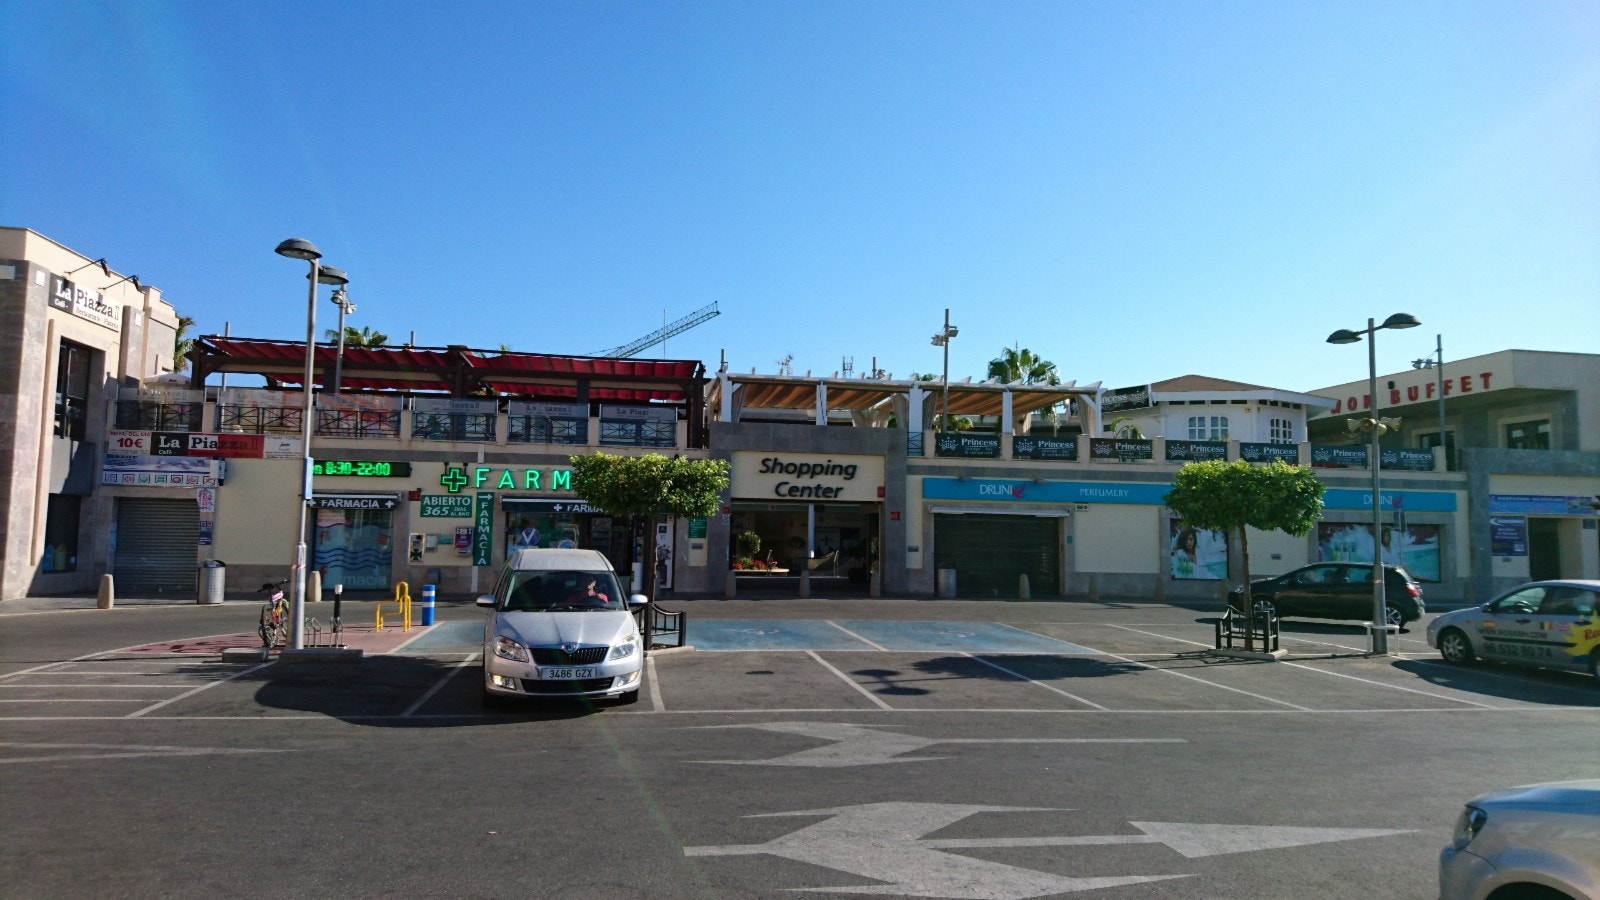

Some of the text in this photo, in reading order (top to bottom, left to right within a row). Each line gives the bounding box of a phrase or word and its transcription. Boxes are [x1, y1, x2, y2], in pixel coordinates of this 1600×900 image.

[56, 279, 72, 302] La
[76, 288, 114, 318] Piazza
[1390, 372, 1492, 405] BUFFET
[117, 437, 144, 449] 10€
[159, 436, 180, 448] La
[190, 437, 248, 449] Piazza
[961, 438, 998, 448] Princess
[1038, 440, 1074, 450] Princess
[1115, 442, 1151, 452] Princess
[1190, 444, 1225, 454] Princess
[1263, 446, 1297, 456] Princess
[1333, 450, 1366, 458] Princess
[1400, 451, 1432, 461] Princess
[759, 458, 857, 480] Shopping
[476, 468, 571, 490] FARM
[775, 482, 844, 498] Center
[980, 484, 1012, 496] DRUNI
[1080, 488, 1130, 498] PERFUMERY
[321, 499, 380, 508] FARMACIA
[423, 496, 471, 506] ABIERTO
[423, 506, 449, 516] 365
[477, 502, 490, 565] FARMACIA
[549, 668, 594, 679] 3486 GZX
